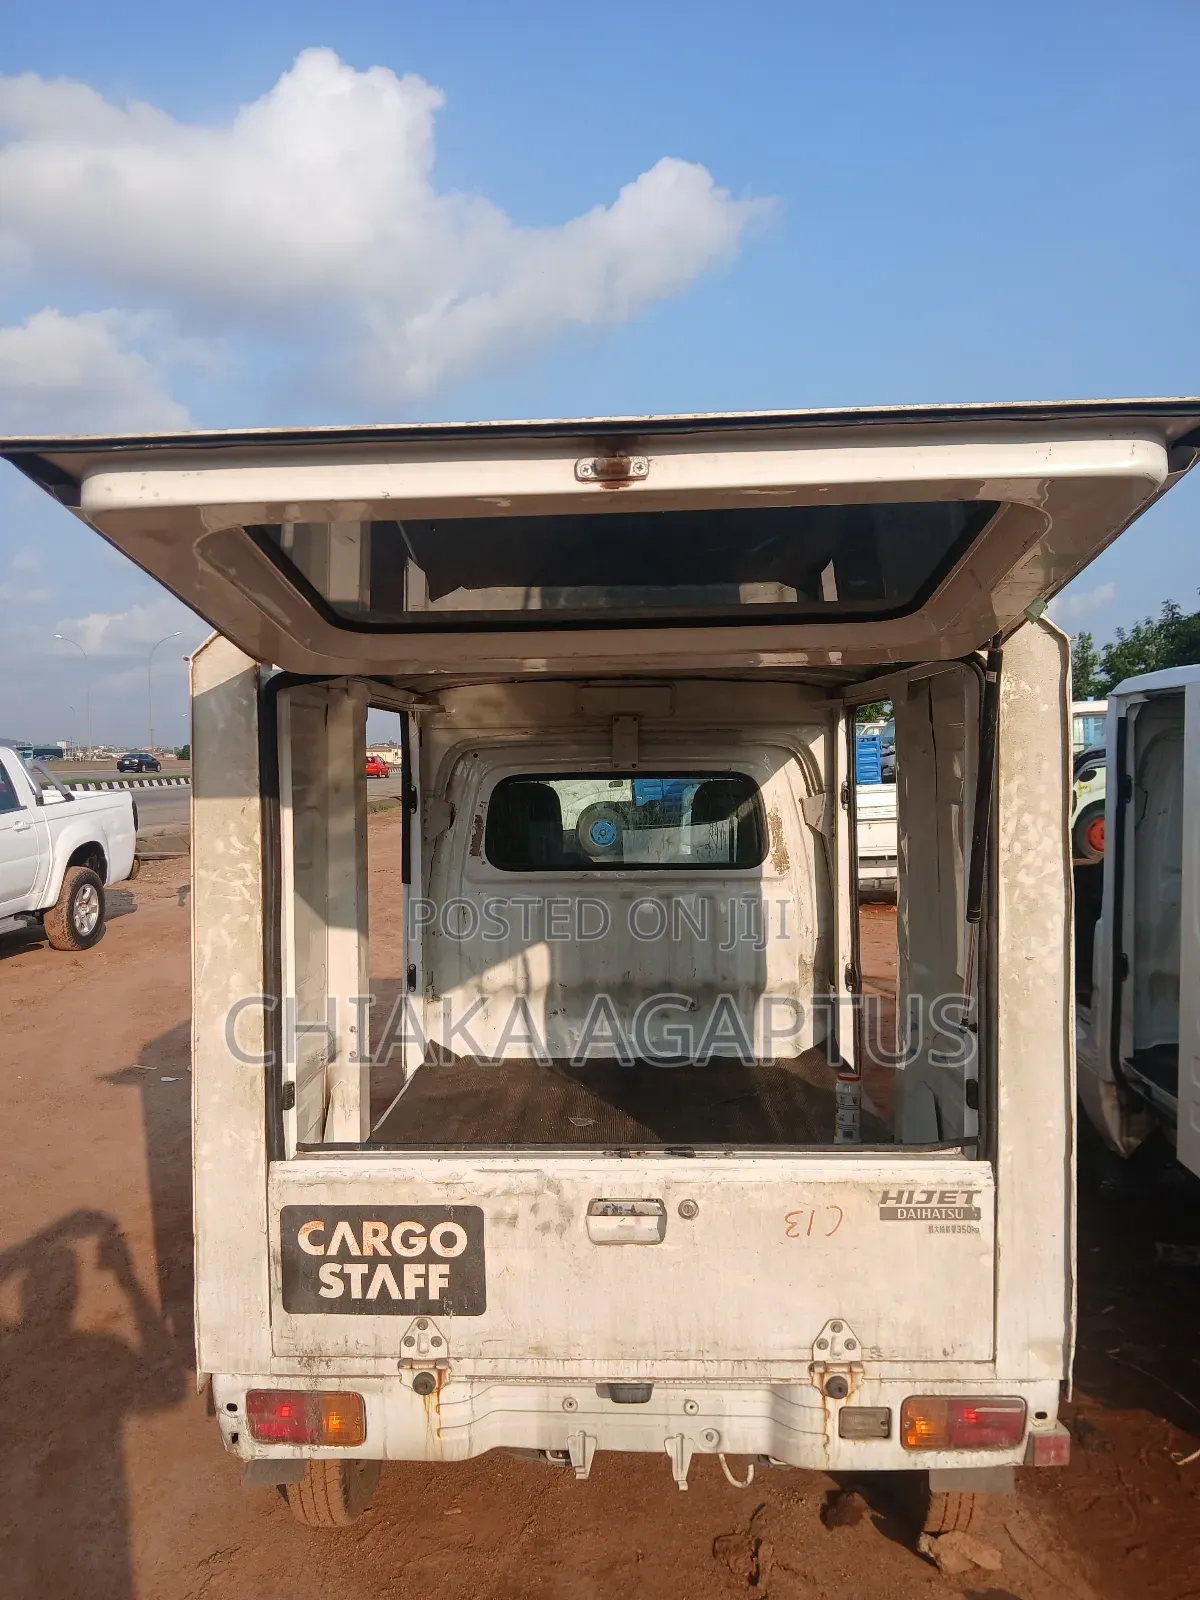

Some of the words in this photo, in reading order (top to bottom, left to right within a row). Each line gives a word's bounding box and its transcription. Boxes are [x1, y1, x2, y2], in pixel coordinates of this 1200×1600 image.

[880, 1190, 982, 1204] HIJET
[897, 1208, 964, 1219] DAIHATSU
[297, 1220, 468, 1258] CARGO
[318, 1262, 449, 1300] STAFF
